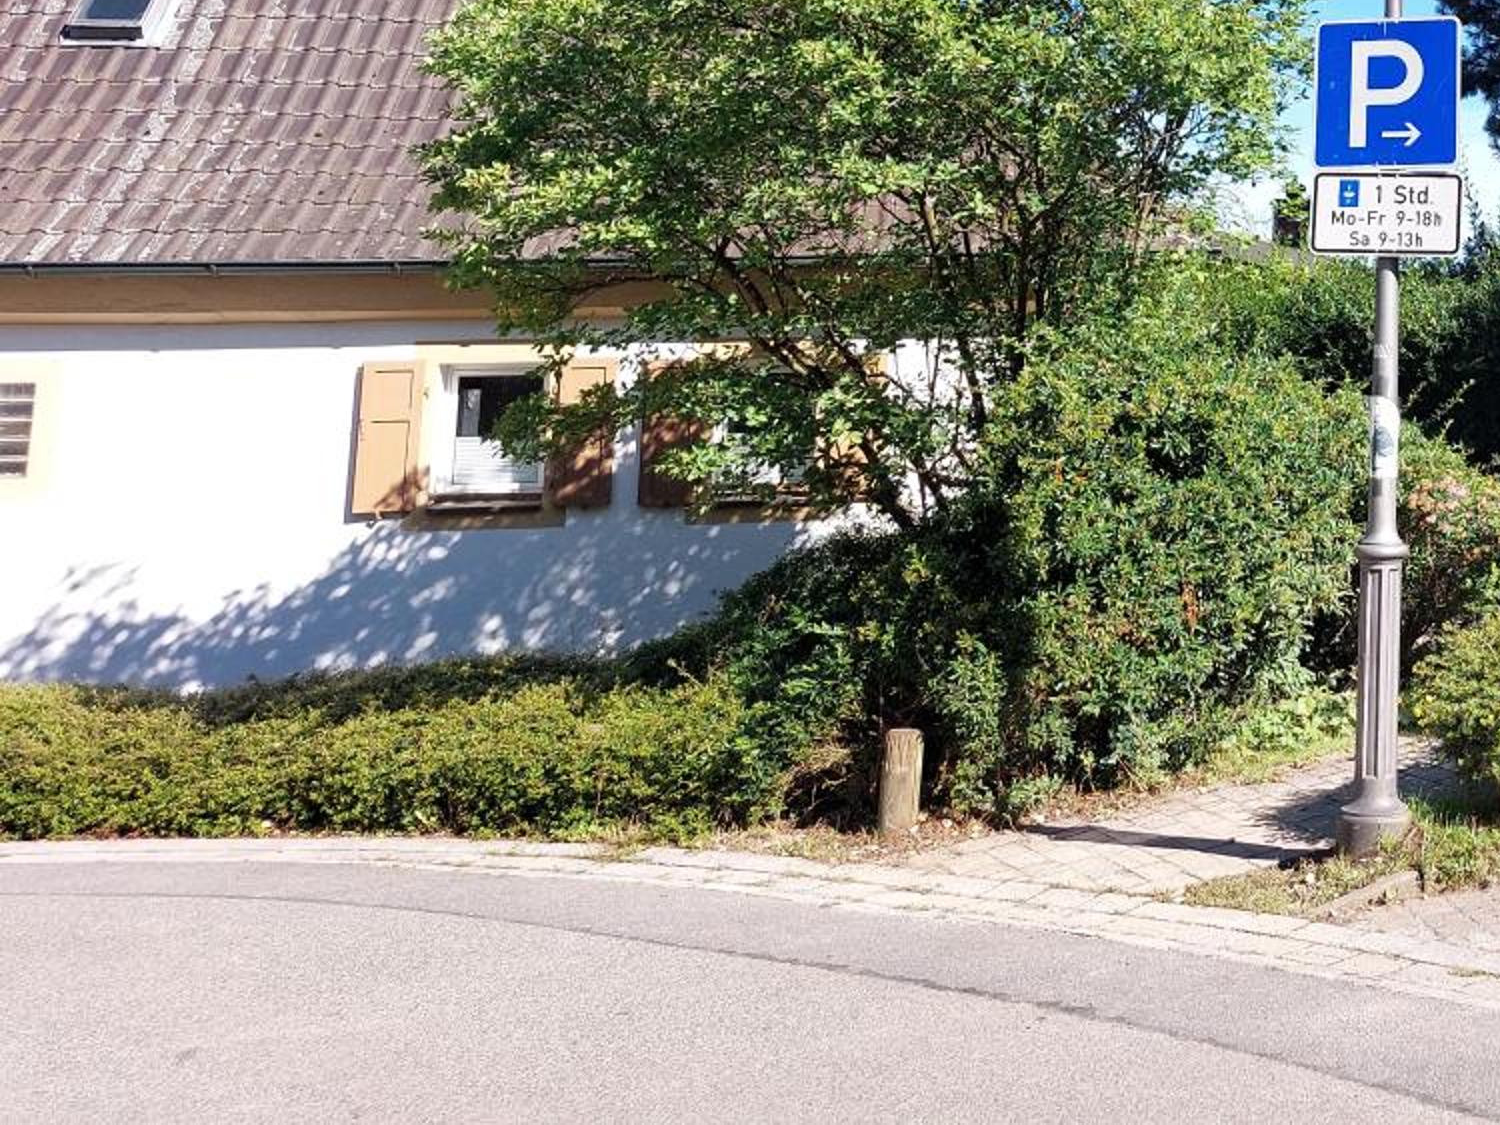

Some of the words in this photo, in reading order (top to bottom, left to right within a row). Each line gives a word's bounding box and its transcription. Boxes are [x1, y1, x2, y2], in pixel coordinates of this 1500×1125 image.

[1349, 39, 1425, 148] P
[1375, 184, 1383, 204] 1
[1331, 210, 1386, 226] Mo-Fr
[1395, 210, 1442, 227] 9-18h
[1349, 230, 1371, 246] Sa
[1378, 231, 1423, 248] 9-13h
